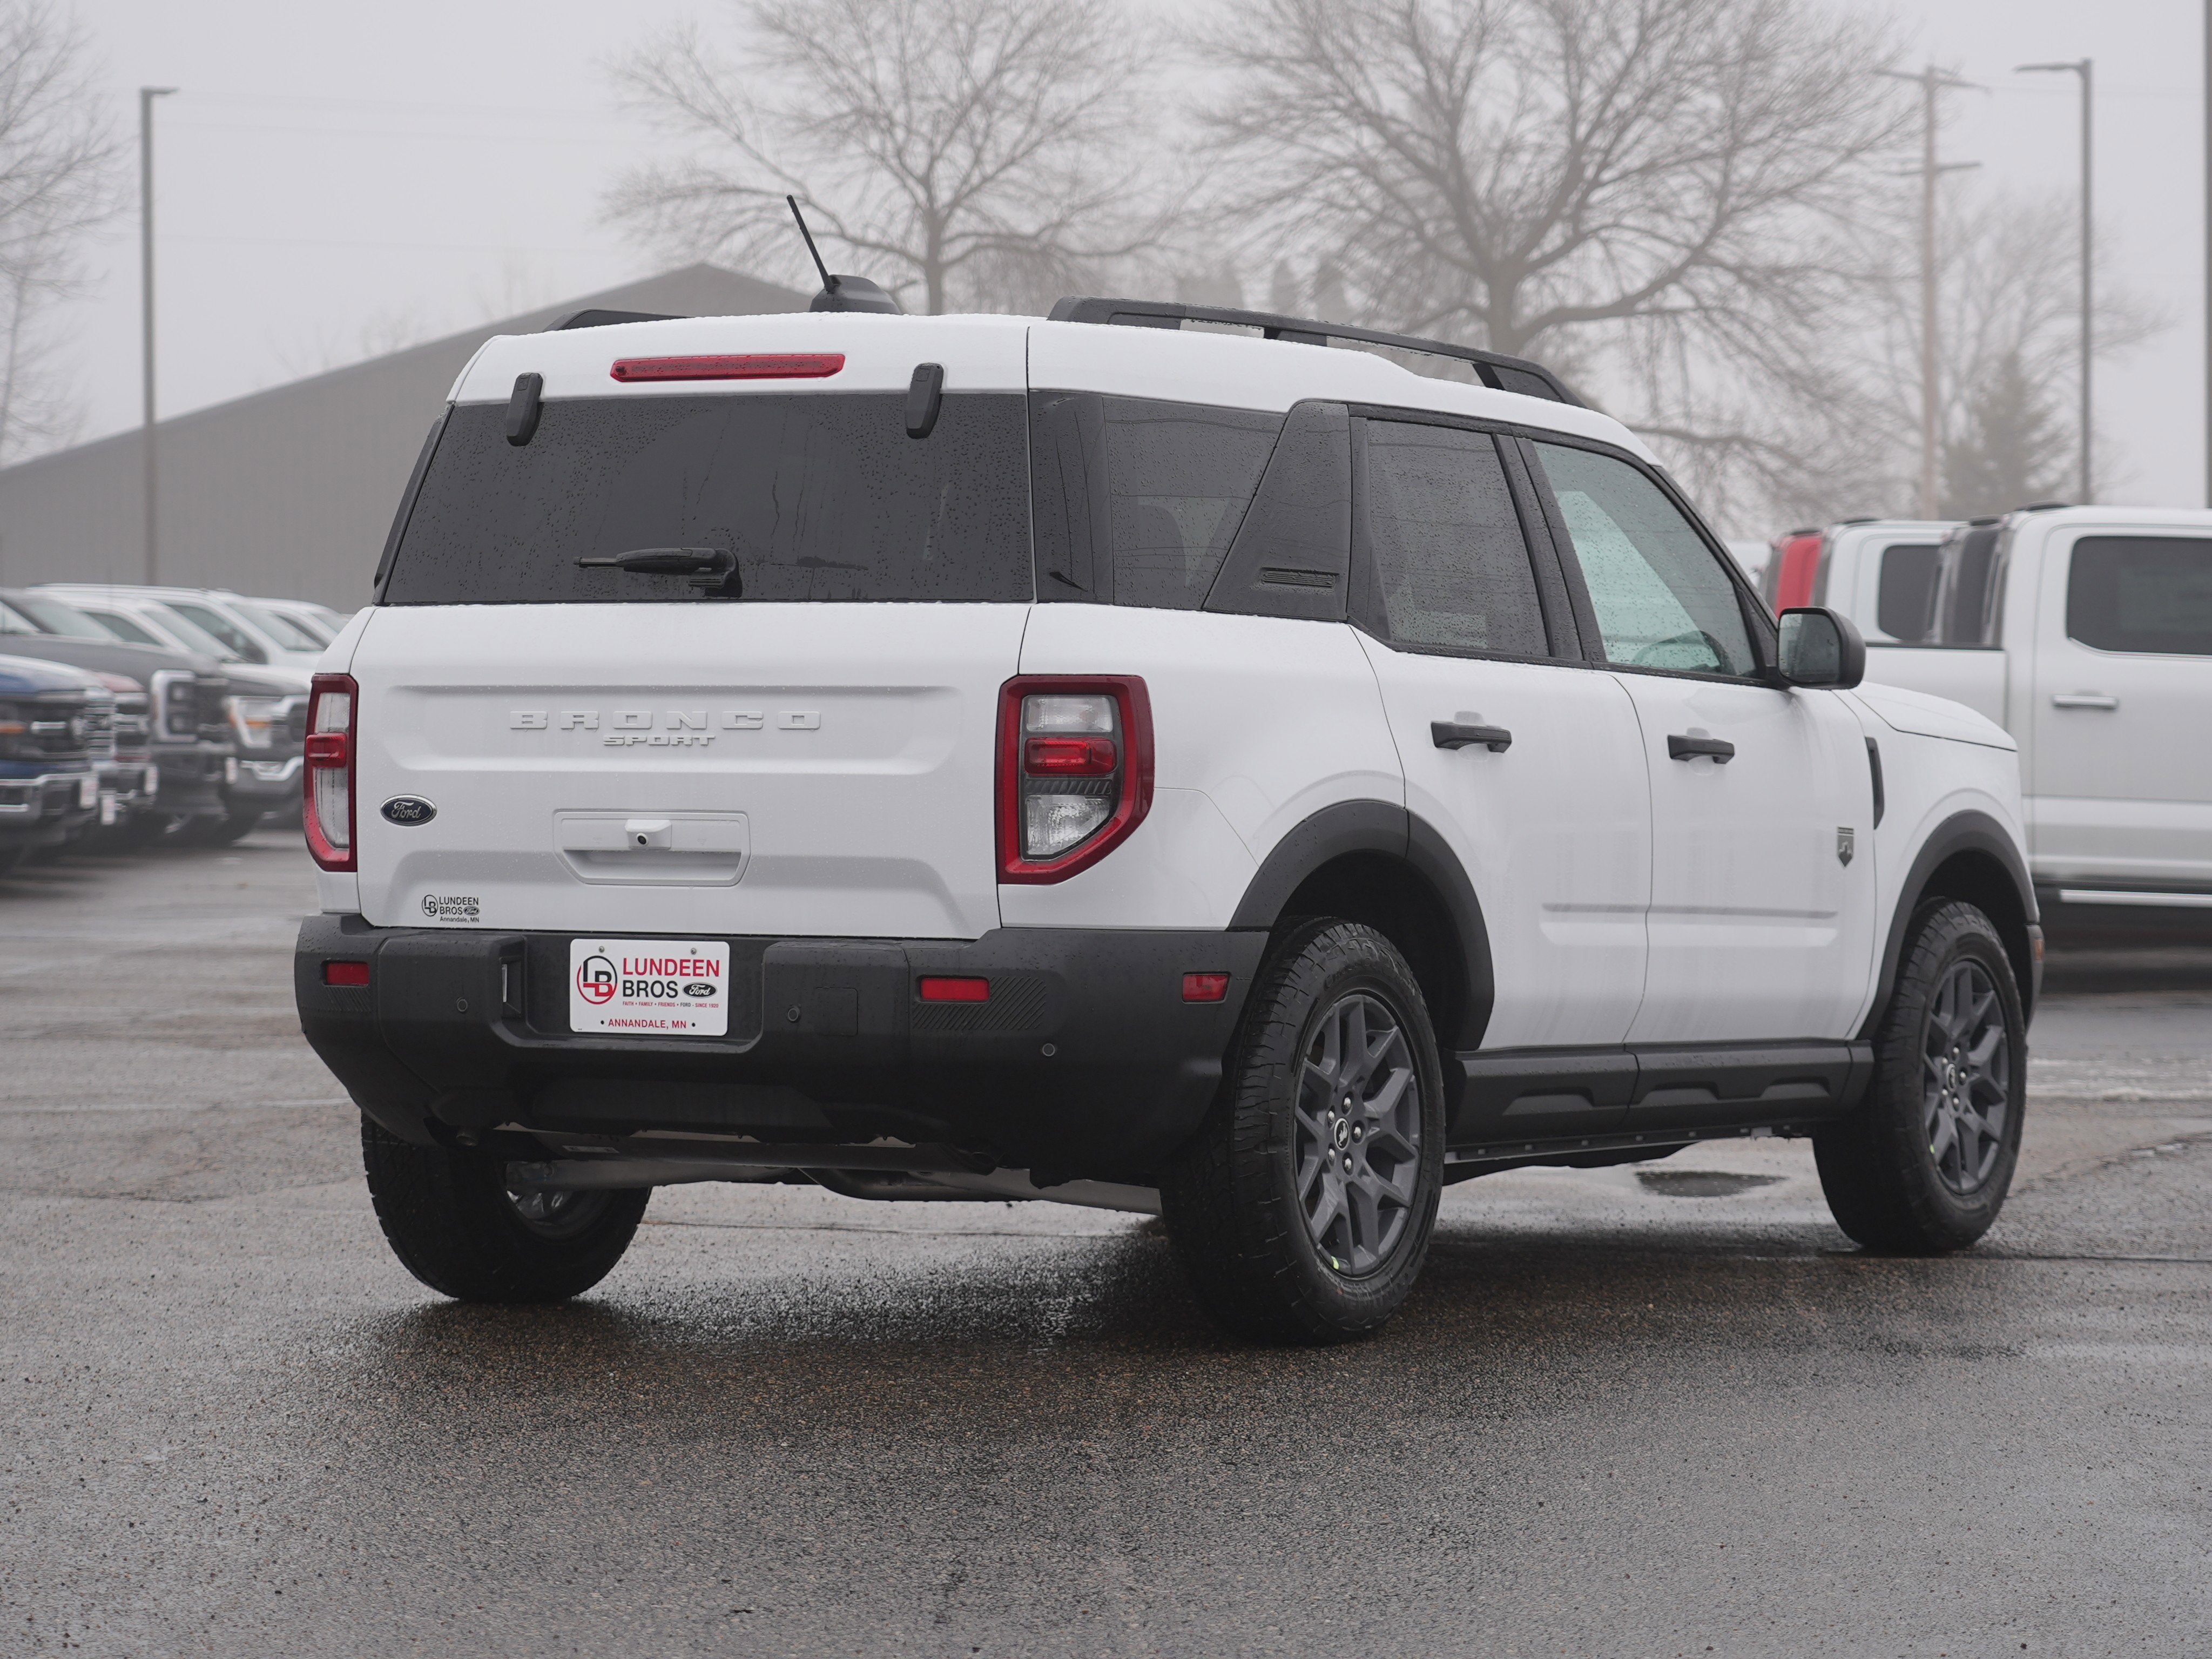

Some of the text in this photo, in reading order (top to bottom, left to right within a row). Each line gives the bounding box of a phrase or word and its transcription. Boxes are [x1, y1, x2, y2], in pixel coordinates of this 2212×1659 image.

[509, 710, 821, 730] BRONCO
[603, 735, 716, 746] SPORT
[391, 801, 422, 819] Ford
[439, 896, 479, 905] LUNDEEN
[440, 906, 463, 915] BROS
[623, 957, 720, 977] LUNDEEN
[622, 980, 678, 999] BROS
[688, 983, 711, 996] Ford
[608, 1019, 686, 1030] ANNANDALE, MN
